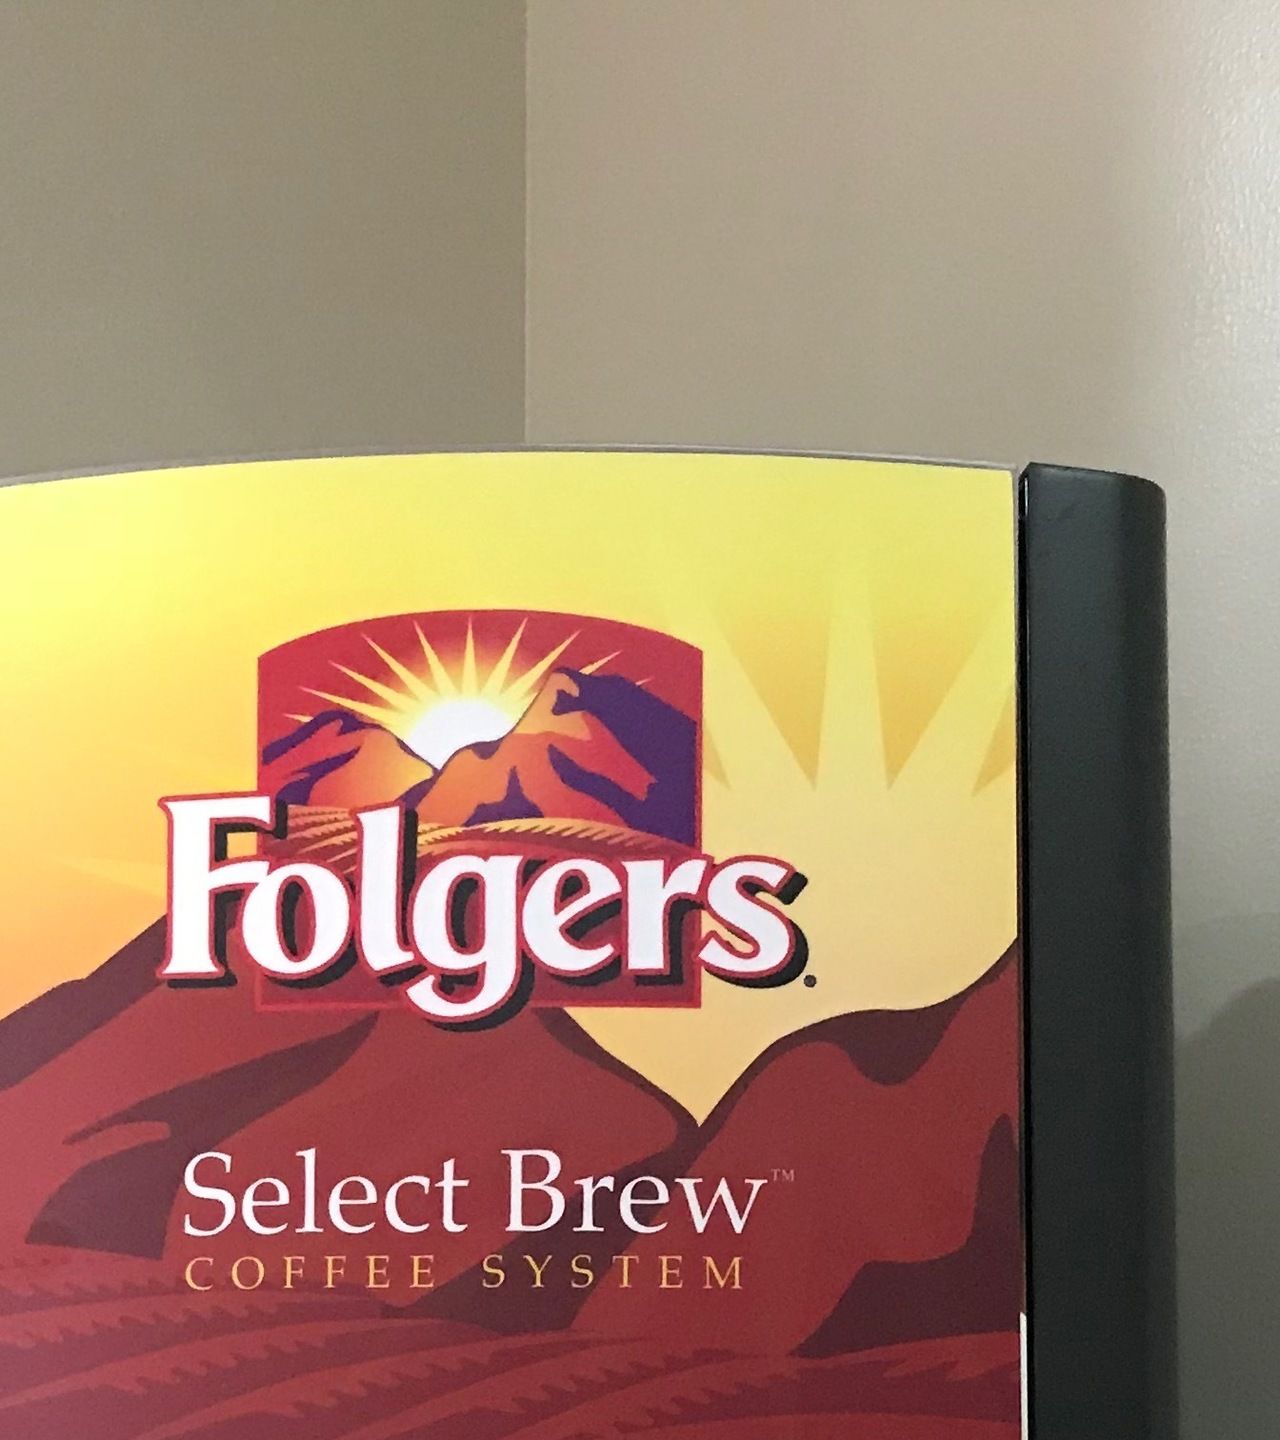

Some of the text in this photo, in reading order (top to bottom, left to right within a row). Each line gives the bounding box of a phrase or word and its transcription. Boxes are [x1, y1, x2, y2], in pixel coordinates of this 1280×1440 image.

[158, 793, 811, 1030] Folgers
[183, 1147, 469, 1237] Select
[501, 1148, 767, 1235] Brew
[184, 1253, 744, 1291] COFFEE SYSTEM
